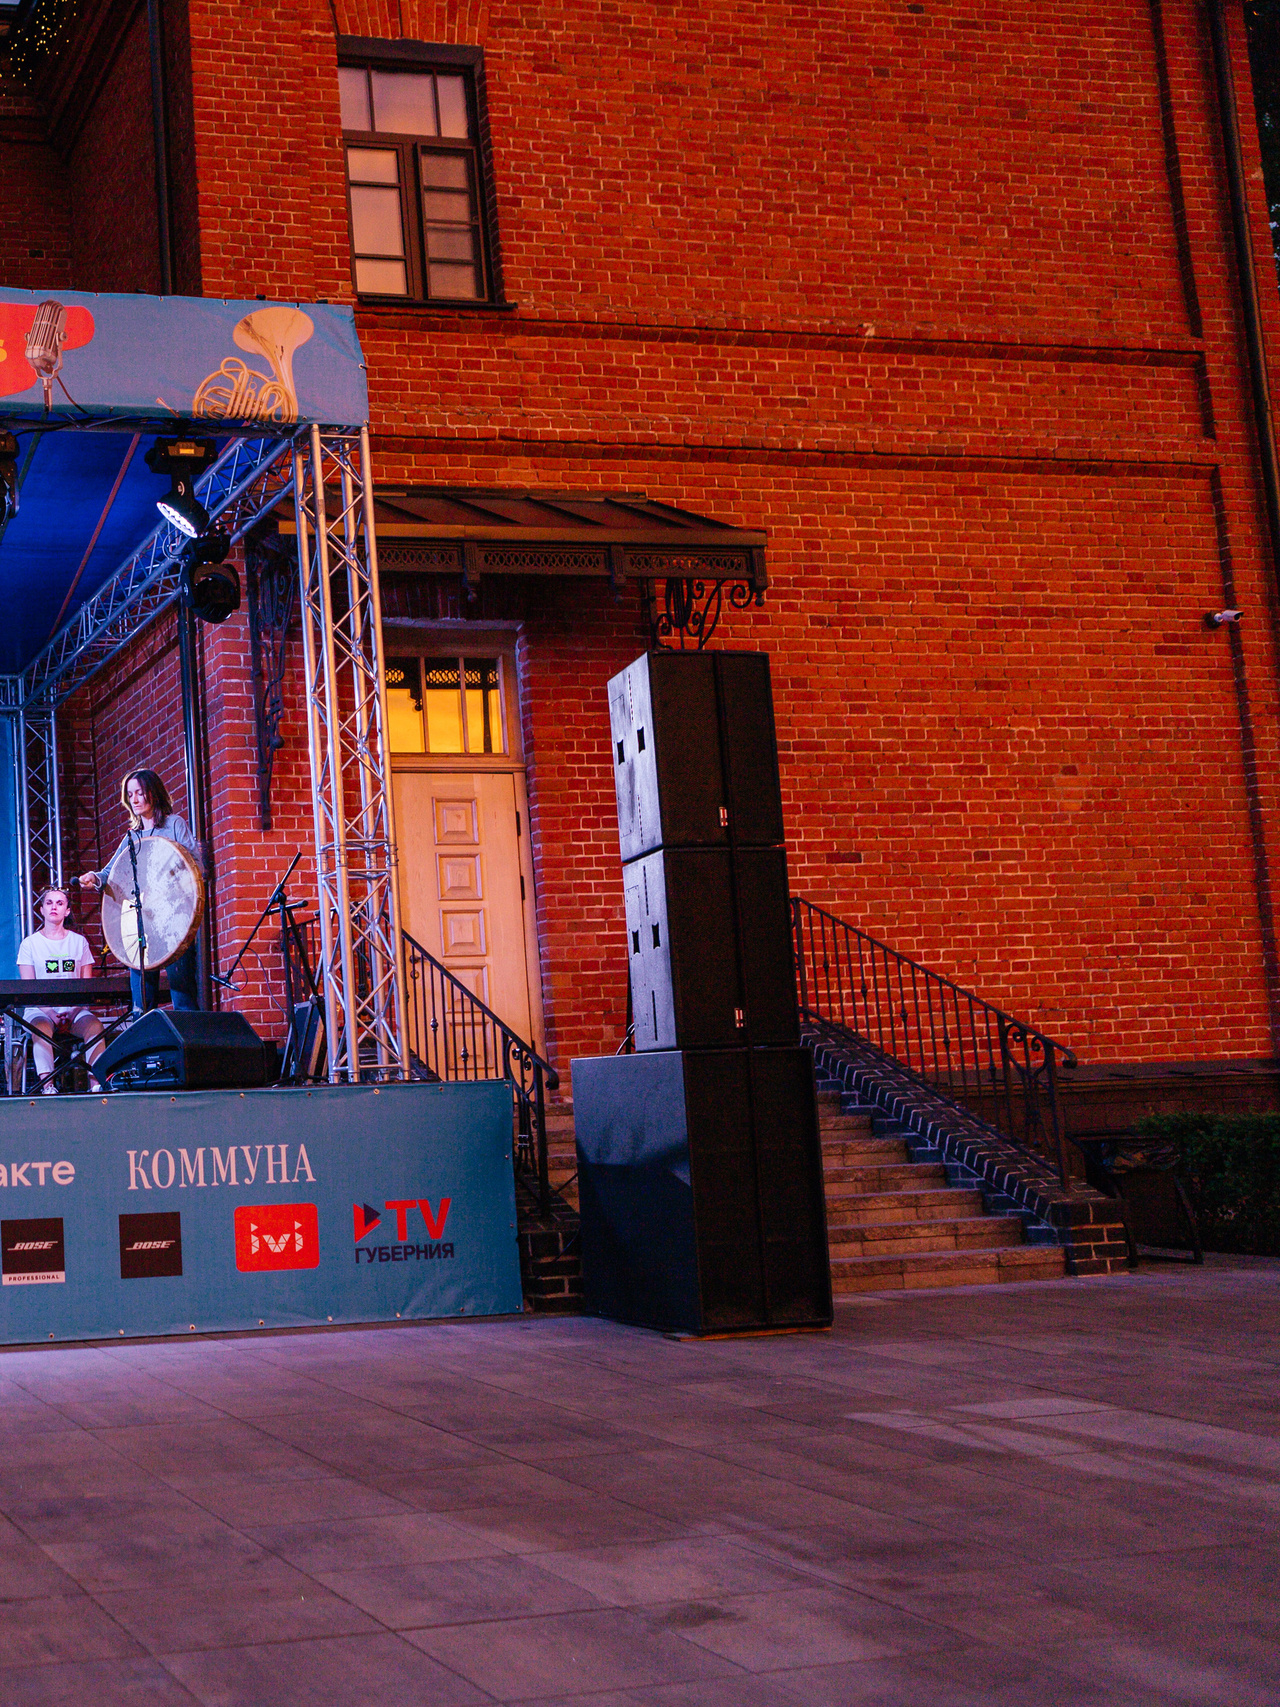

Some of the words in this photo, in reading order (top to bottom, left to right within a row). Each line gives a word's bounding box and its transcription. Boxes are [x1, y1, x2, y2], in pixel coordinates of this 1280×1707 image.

[126, 1143, 317, 1190] КОММУНА
[385, 1198, 452, 1242] TV
[7, 1241, 58, 1251] BOSE
[125, 1240, 176, 1250] BOSE
[250, 1220, 303, 1255] ivi
[354, 1242, 455, 1264] ГУБЕРНИЯ
[8, 1274, 60, 1282] PROFESSIONAL
